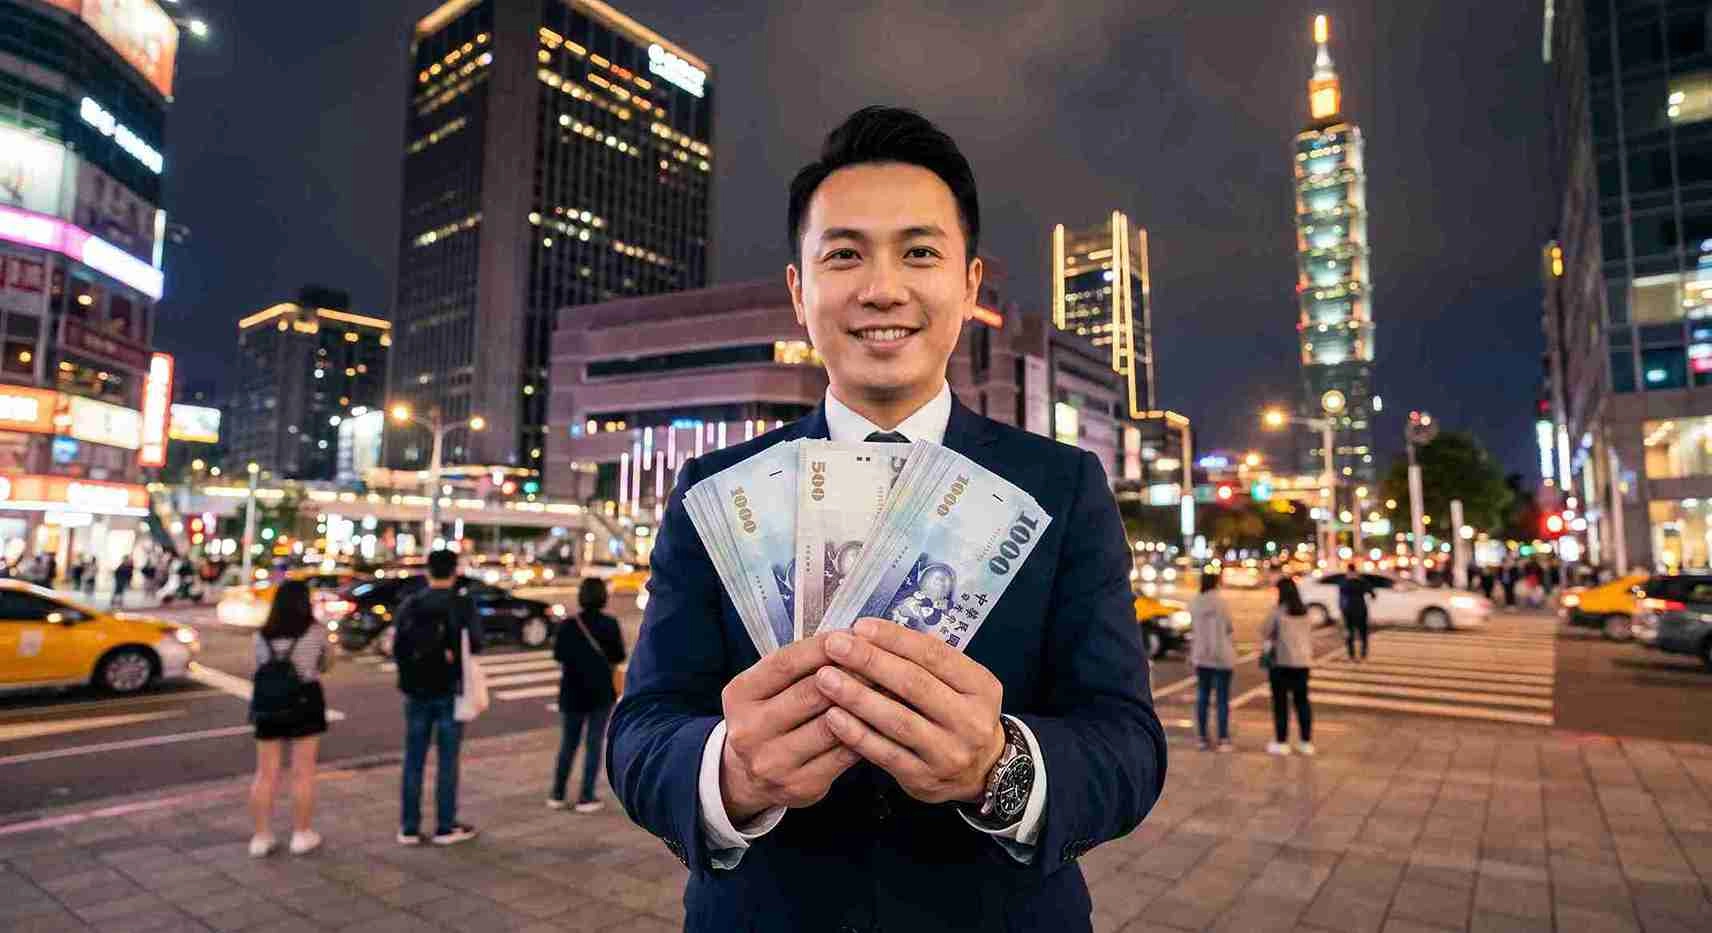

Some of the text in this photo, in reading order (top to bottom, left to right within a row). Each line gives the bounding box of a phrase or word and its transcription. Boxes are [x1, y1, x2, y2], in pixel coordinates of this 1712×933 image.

[811, 461, 826, 501] 500
[937, 474, 968, 516] 1000
[730, 486, 757, 534] 1000
[989, 510, 1039, 575] 1000
